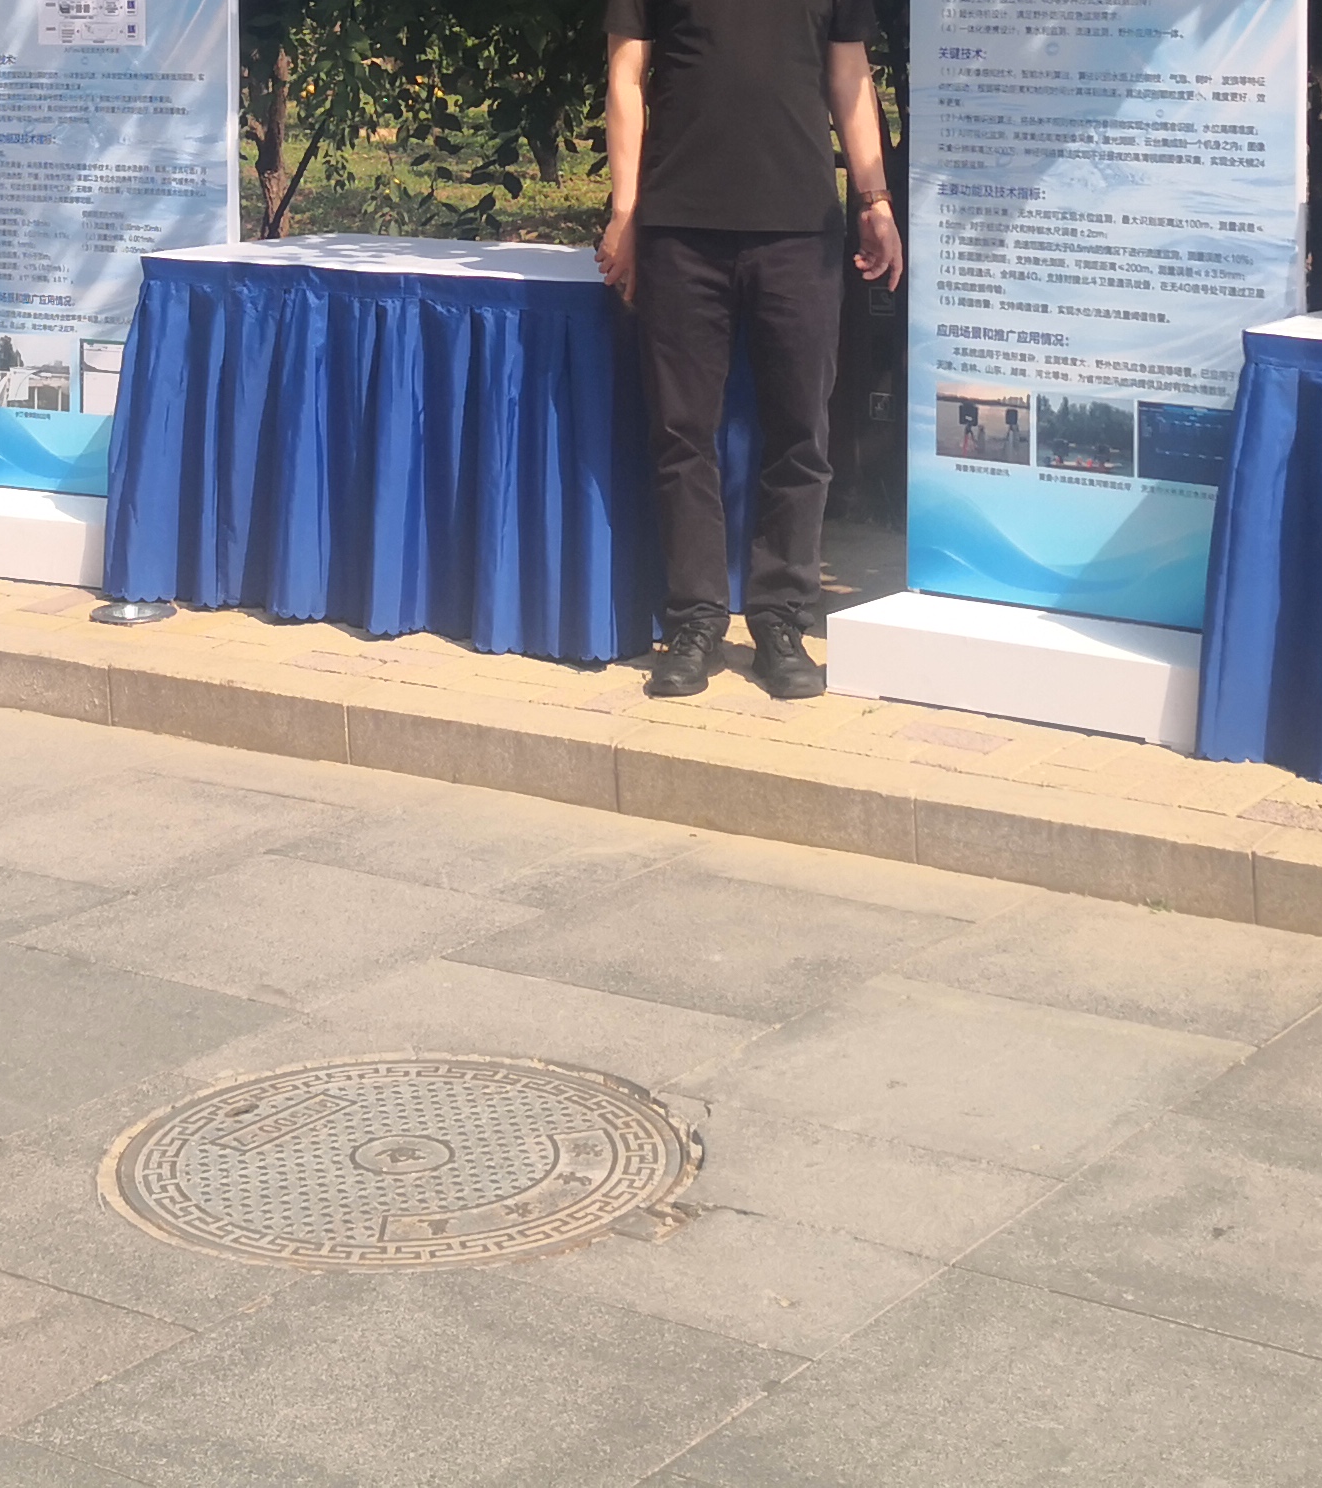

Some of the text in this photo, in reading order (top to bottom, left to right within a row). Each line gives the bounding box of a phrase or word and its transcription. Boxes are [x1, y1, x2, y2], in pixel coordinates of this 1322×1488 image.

[937, 183, 1046, 200] 主要功能及技术指标：
[937, 324, 1069, 347] 应用场景和推广应用情况：
